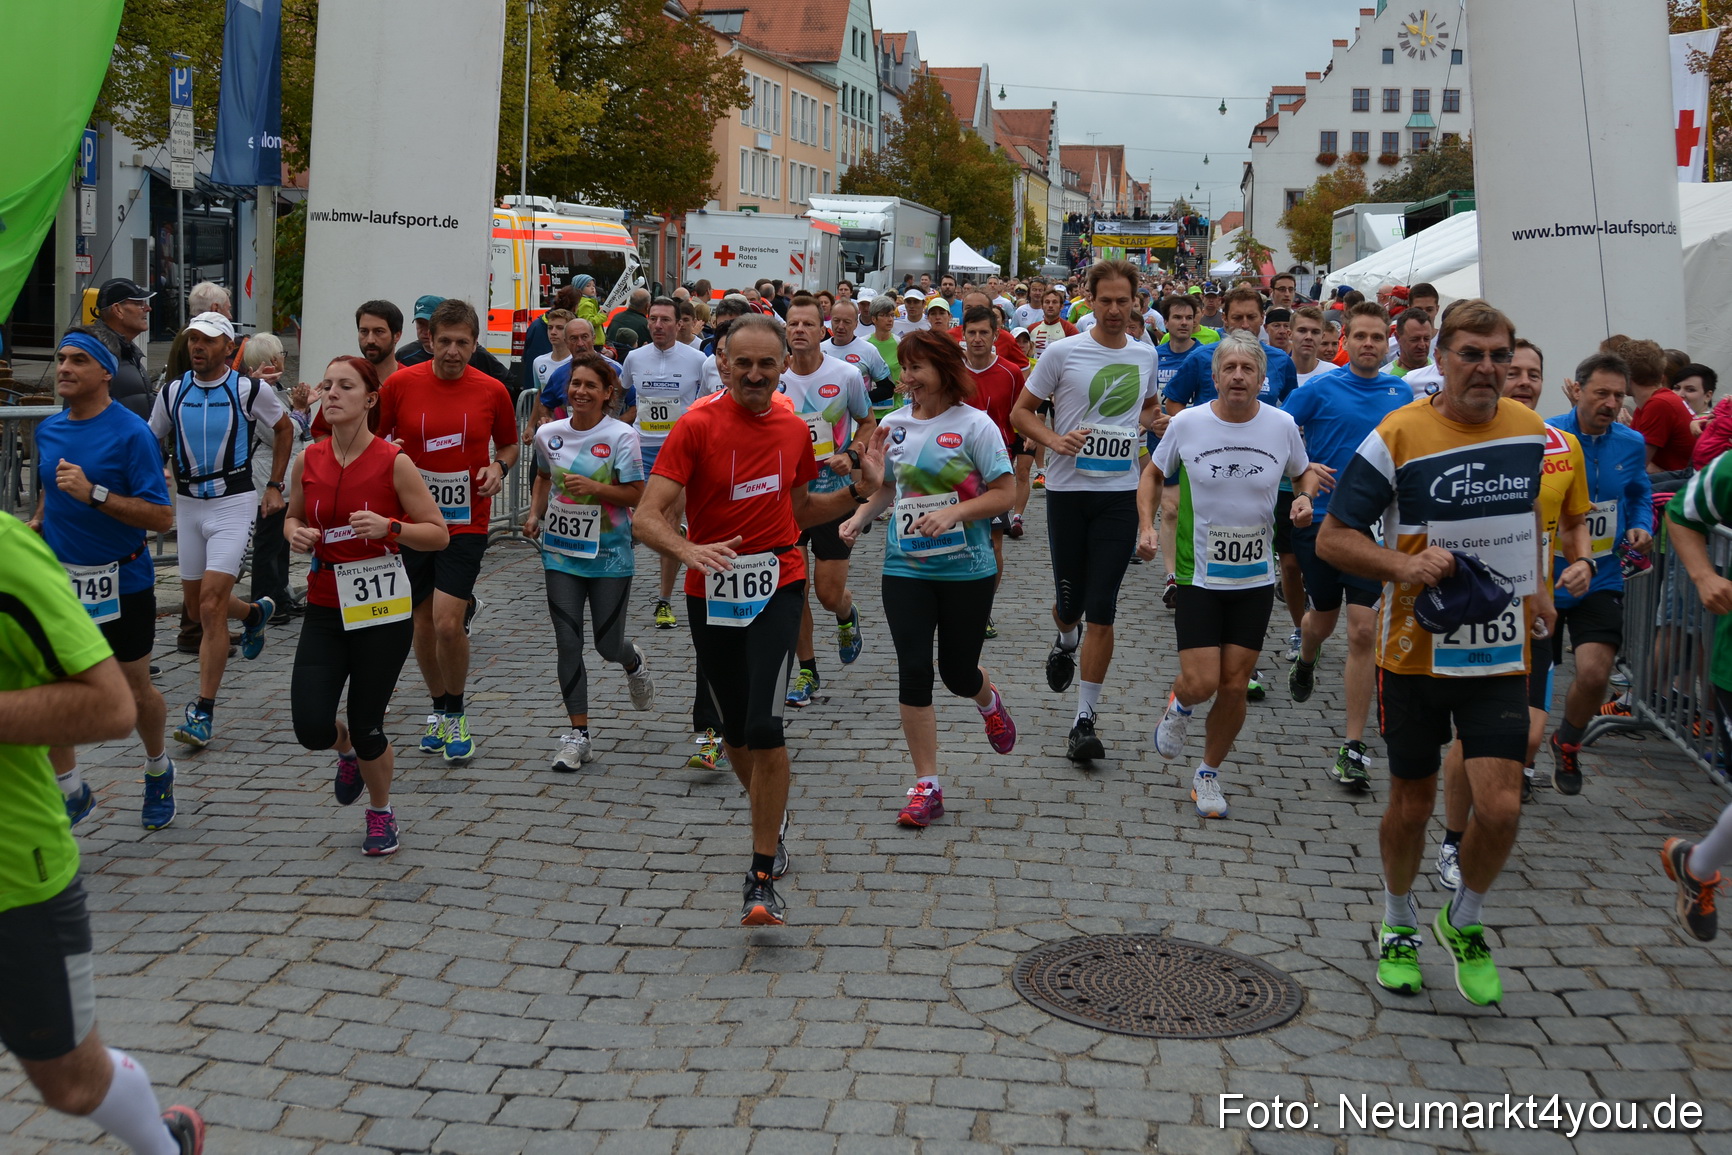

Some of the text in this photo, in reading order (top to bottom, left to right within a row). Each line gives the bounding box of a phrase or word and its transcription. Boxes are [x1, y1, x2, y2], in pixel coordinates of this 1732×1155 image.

[310, 209, 459, 228] www.bmw-laufsport.de
[1512, 220, 1677, 241] www.bmw-laufsport.de
[739, 246, 779, 254] Bayerisches
[650, 406, 668, 420] 80
[1083, 436, 1131, 457] 3008
[1541, 459, 1574, 475] ÖGL
[746, 482, 767, 493] DEHN
[1451, 474, 1530, 497] Fischer
[916, 500, 948, 508] Neumarkt
[1461, 492, 1528, 506] AUTOMOBILE
[548, 513, 594, 538] 2637
[334, 529, 352, 538] DEHN
[1430, 529, 1532, 548] Alles Gute und viel
[554, 538, 585, 550] Manuela
[912, 538, 952, 550] Sieglinde
[1214, 539, 1263, 562] 3043
[337, 562, 395, 577] PARTL Neumarkt
[732, 561, 766, 570] Neumarkt
[353, 572, 396, 602] 317
[713, 570, 772, 599] 2168
[372, 606, 388, 616] Eva
[733, 606, 752, 616] Karl
[1444, 612, 1517, 644] 2163
[1468, 652, 1492, 664] Otto
